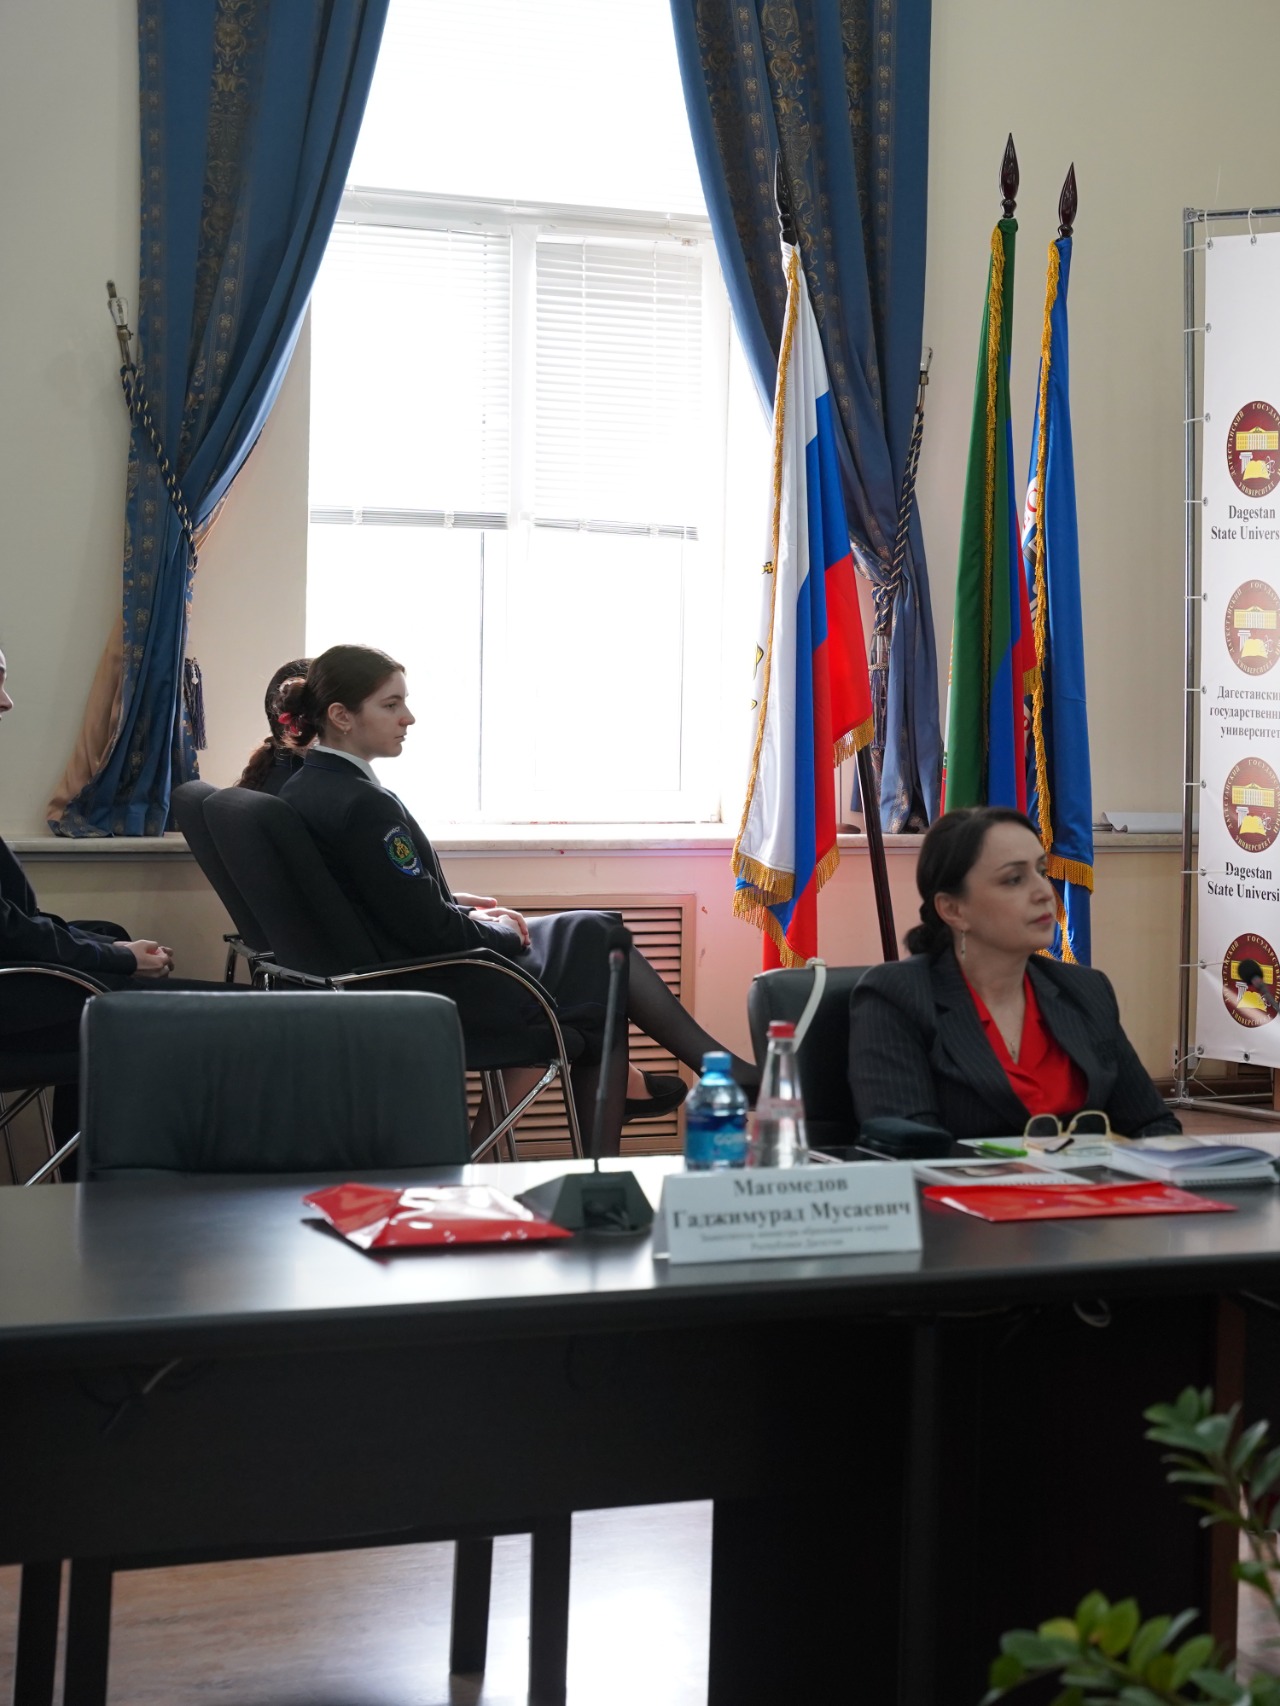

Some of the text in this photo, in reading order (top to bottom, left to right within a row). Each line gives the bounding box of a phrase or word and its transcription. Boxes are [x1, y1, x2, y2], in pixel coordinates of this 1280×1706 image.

[1229, 505, 1275, 523] Dagestan
[1211, 526, 1237, 540] State
[1220, 726, 1280, 740] университет
[1225, 862, 1272, 881] Dagestan
[1208, 881, 1234, 897] State
[734, 1178, 848, 1196] Магомедов
[673, 1202, 910, 1229] Гаджимурад Мусаевич
